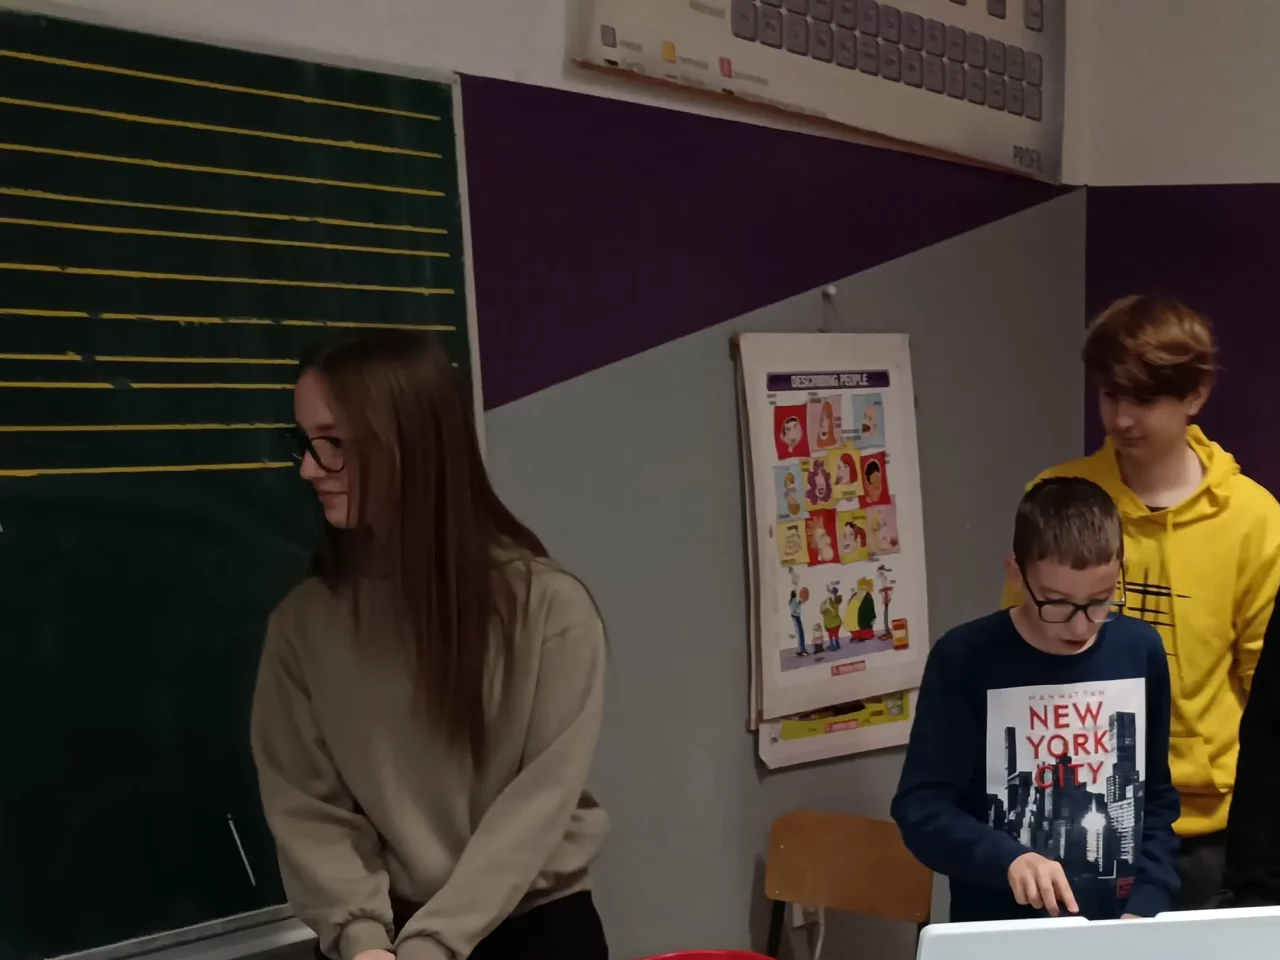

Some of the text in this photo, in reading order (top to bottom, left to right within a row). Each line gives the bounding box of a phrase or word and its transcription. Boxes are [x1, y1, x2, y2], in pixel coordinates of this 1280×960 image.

[839, 373, 868, 386] PEOPLE
[1028, 690, 1105, 701] MANHATTAN
[1029, 701, 1103, 731] NEW
[1025, 729, 1110, 760] YORK
[1034, 760, 1104, 789] CITY
